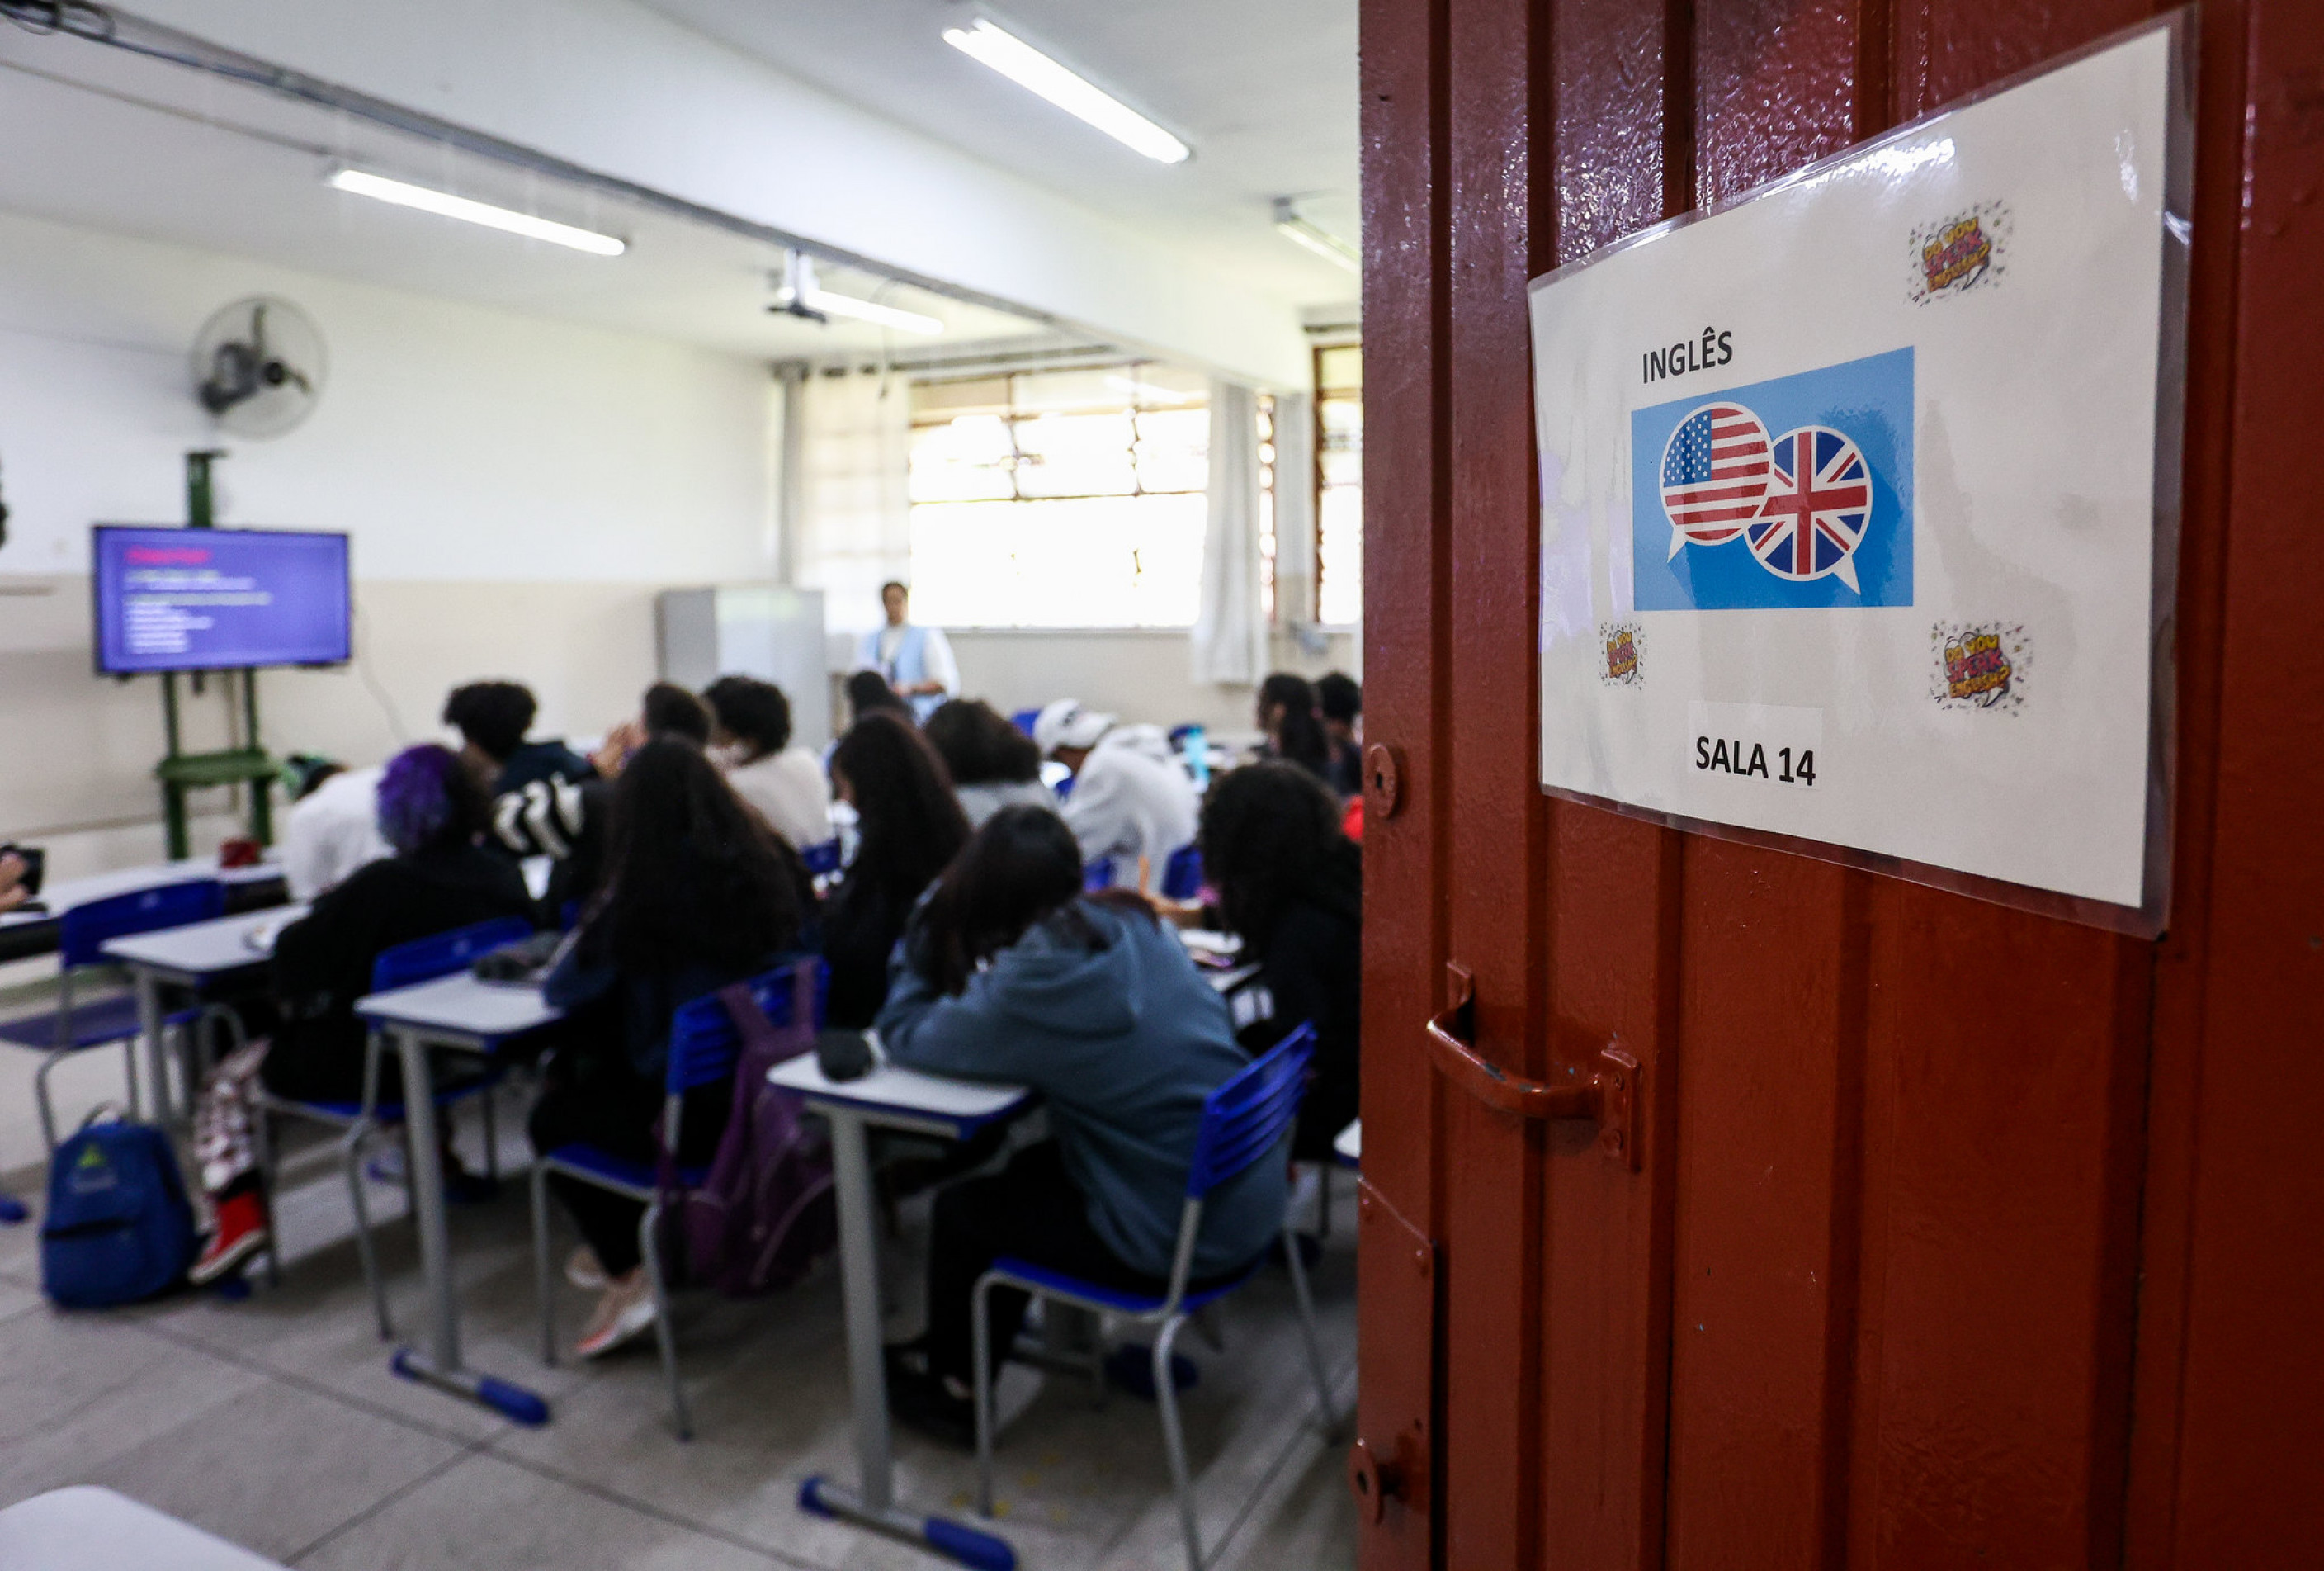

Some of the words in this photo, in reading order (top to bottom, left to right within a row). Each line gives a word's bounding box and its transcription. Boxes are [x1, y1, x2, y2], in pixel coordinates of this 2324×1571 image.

[1643, 326, 1732, 384] INGLÊS
[1696, 736, 1769, 779] SALA
[1778, 747, 1816, 787] 14
